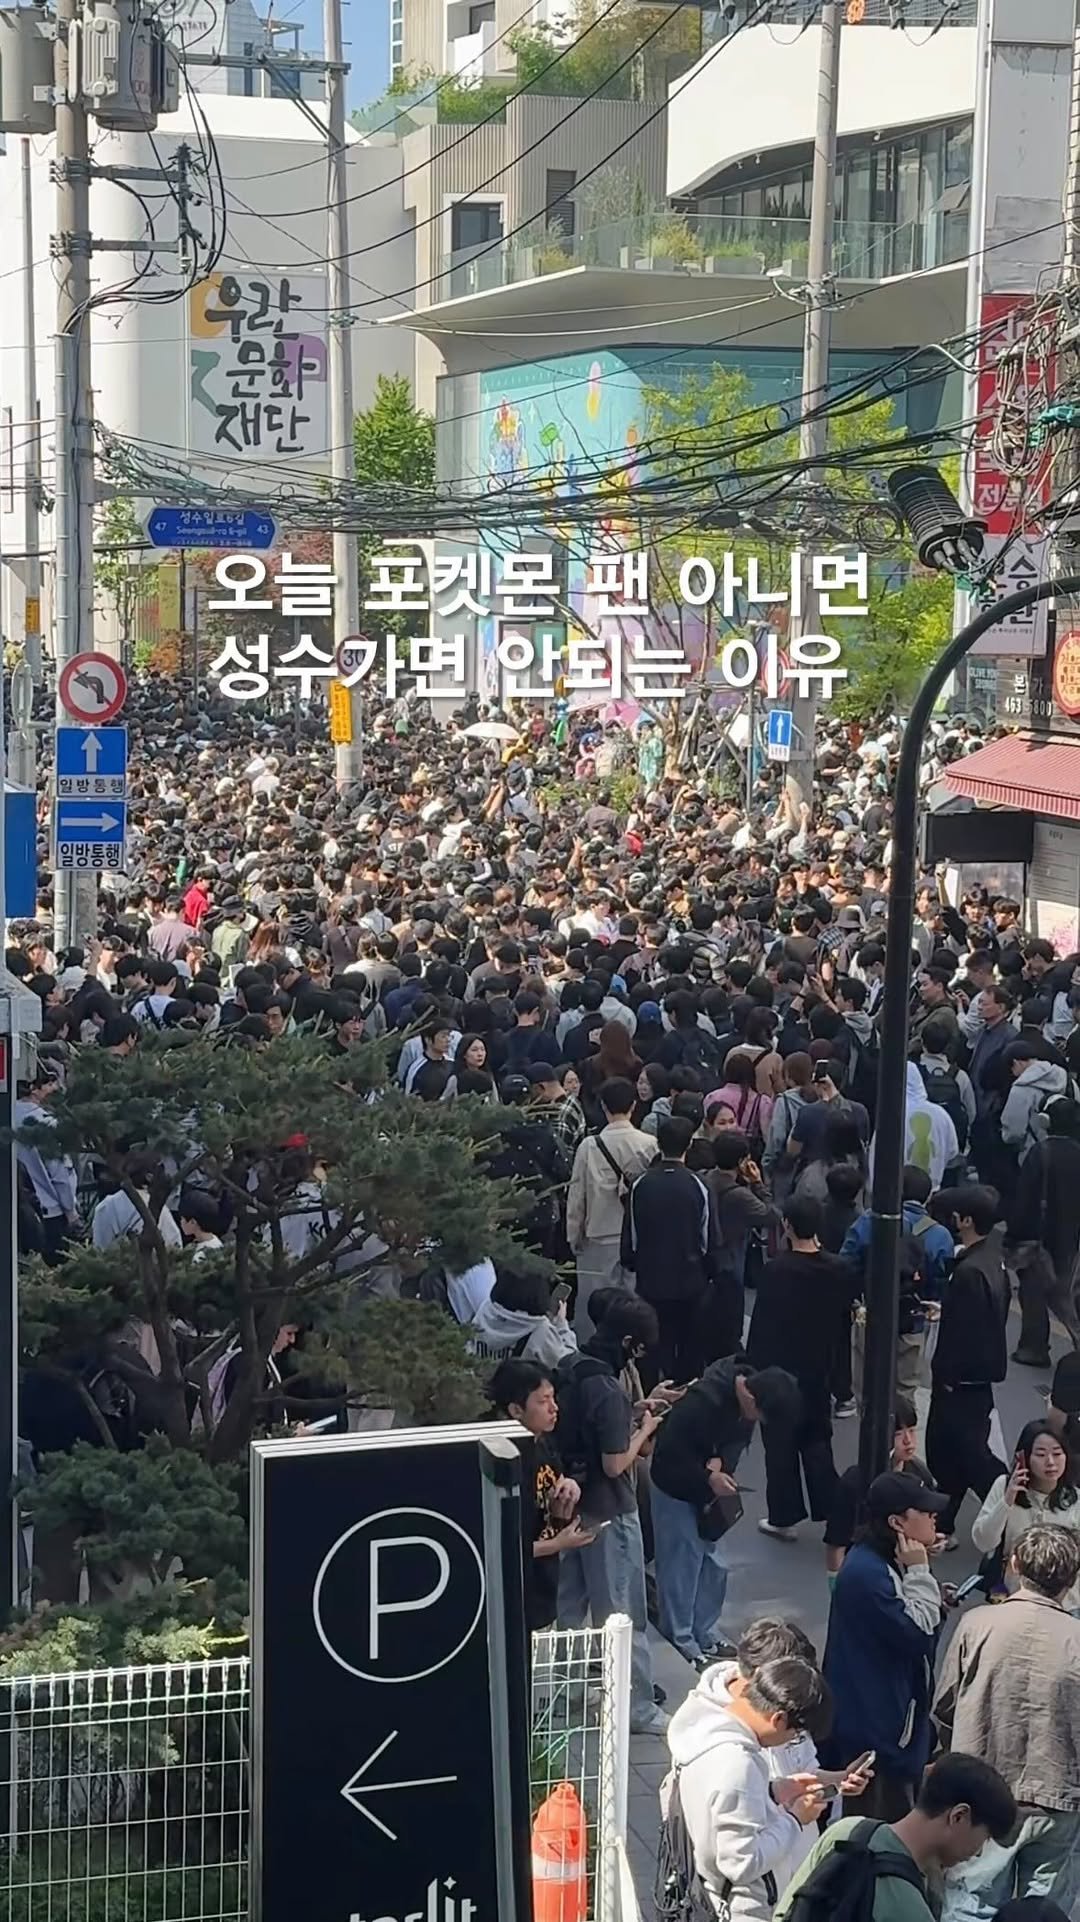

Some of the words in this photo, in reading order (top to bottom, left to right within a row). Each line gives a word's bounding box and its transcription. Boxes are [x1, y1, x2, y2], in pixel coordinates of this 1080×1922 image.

[204, 275, 302, 344] 우란
[226, 340, 317, 401] 문화
[214, 401, 311, 452] 재단
[256, 524, 270, 535] 43
[343, 648, 367, 667] 30
[60, 778, 124, 794] 일방통행
[60, 842, 121, 868] 일방통행
[369, 1535, 451, 1660] P
